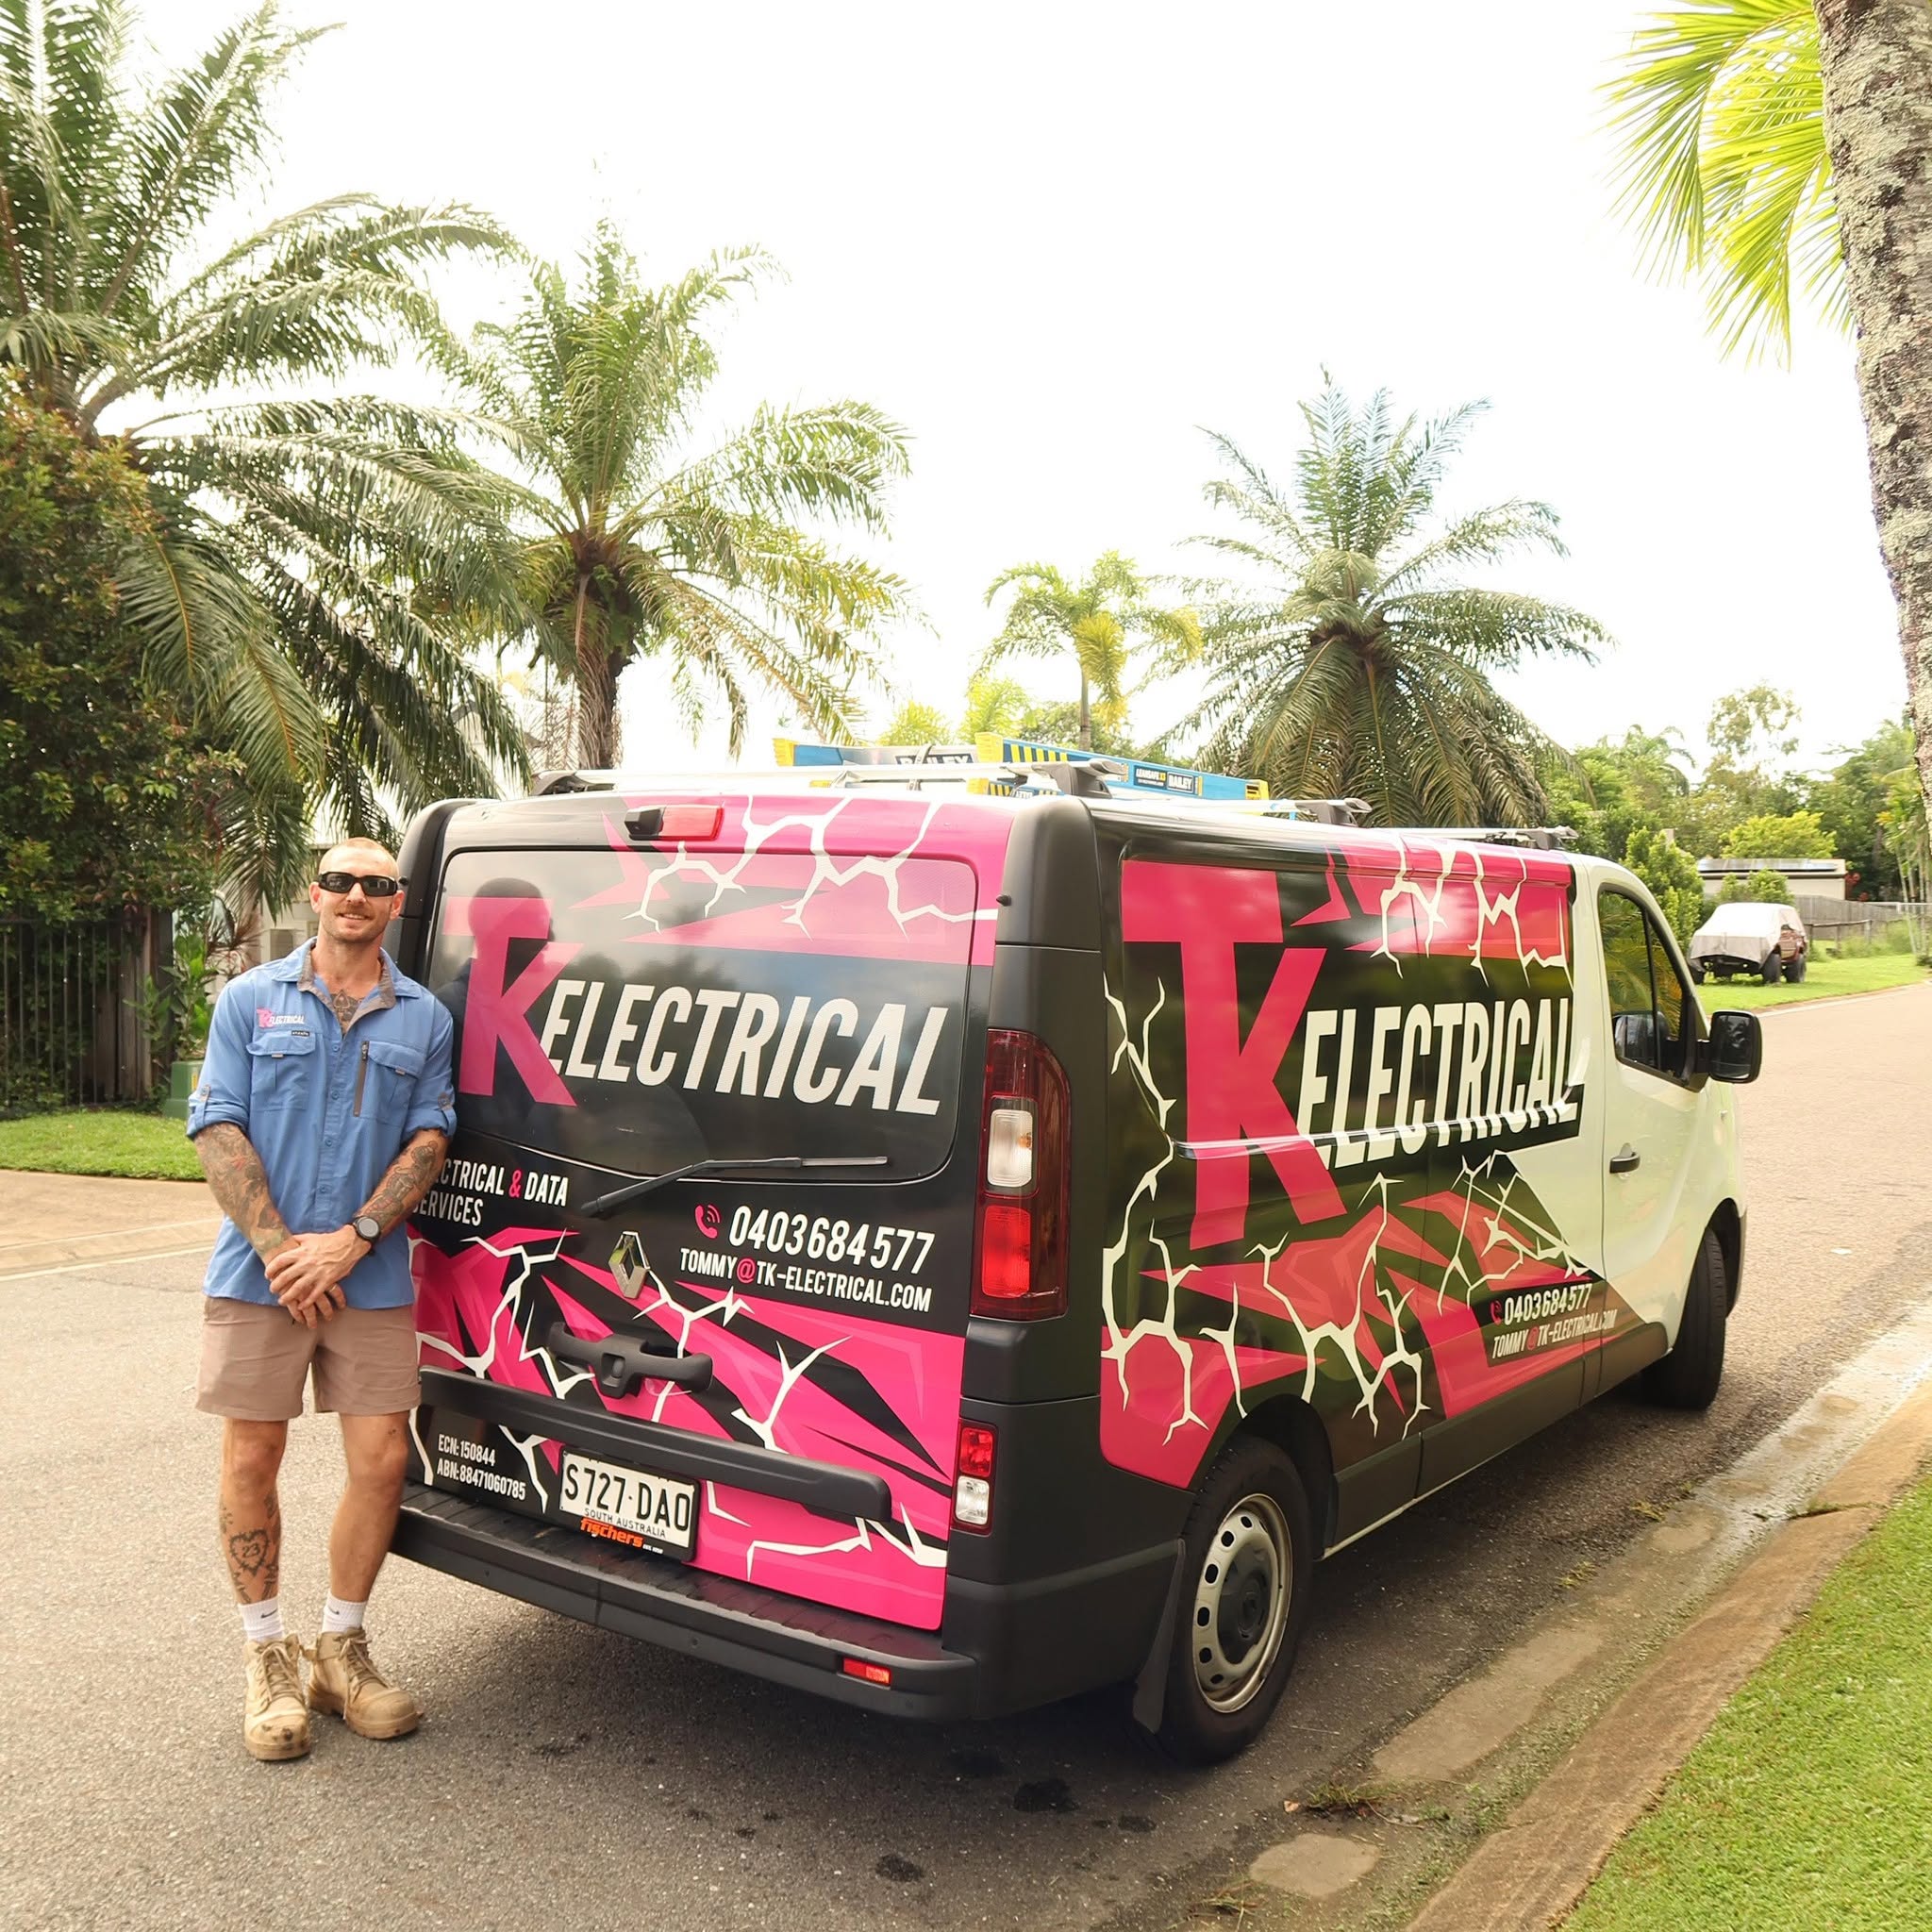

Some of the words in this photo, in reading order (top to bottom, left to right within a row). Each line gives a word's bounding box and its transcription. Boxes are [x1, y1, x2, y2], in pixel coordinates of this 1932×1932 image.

[1168, 774, 1193, 791] BAILEY
[271, 1014, 305, 1025] ELECTRICAL
[442, 897, 585, 1107] TK
[540, 979, 949, 1116] ELECTRICAL
[1122, 860, 1347, 1250] TK
[1298, 998, 1579, 1170] ELECTRICAL
[436, 1158, 506, 1196] CTRICAL
[508, 1169, 524, 1198] &
[524, 1172, 569, 1208] DATA
[680, 1247, 933, 1313] TOMMY@TK-ELECTRICAL.COM
[584, 1507, 613, 1524] SOUTH
[616, 1520, 666, 1540] AUSTRALIA
